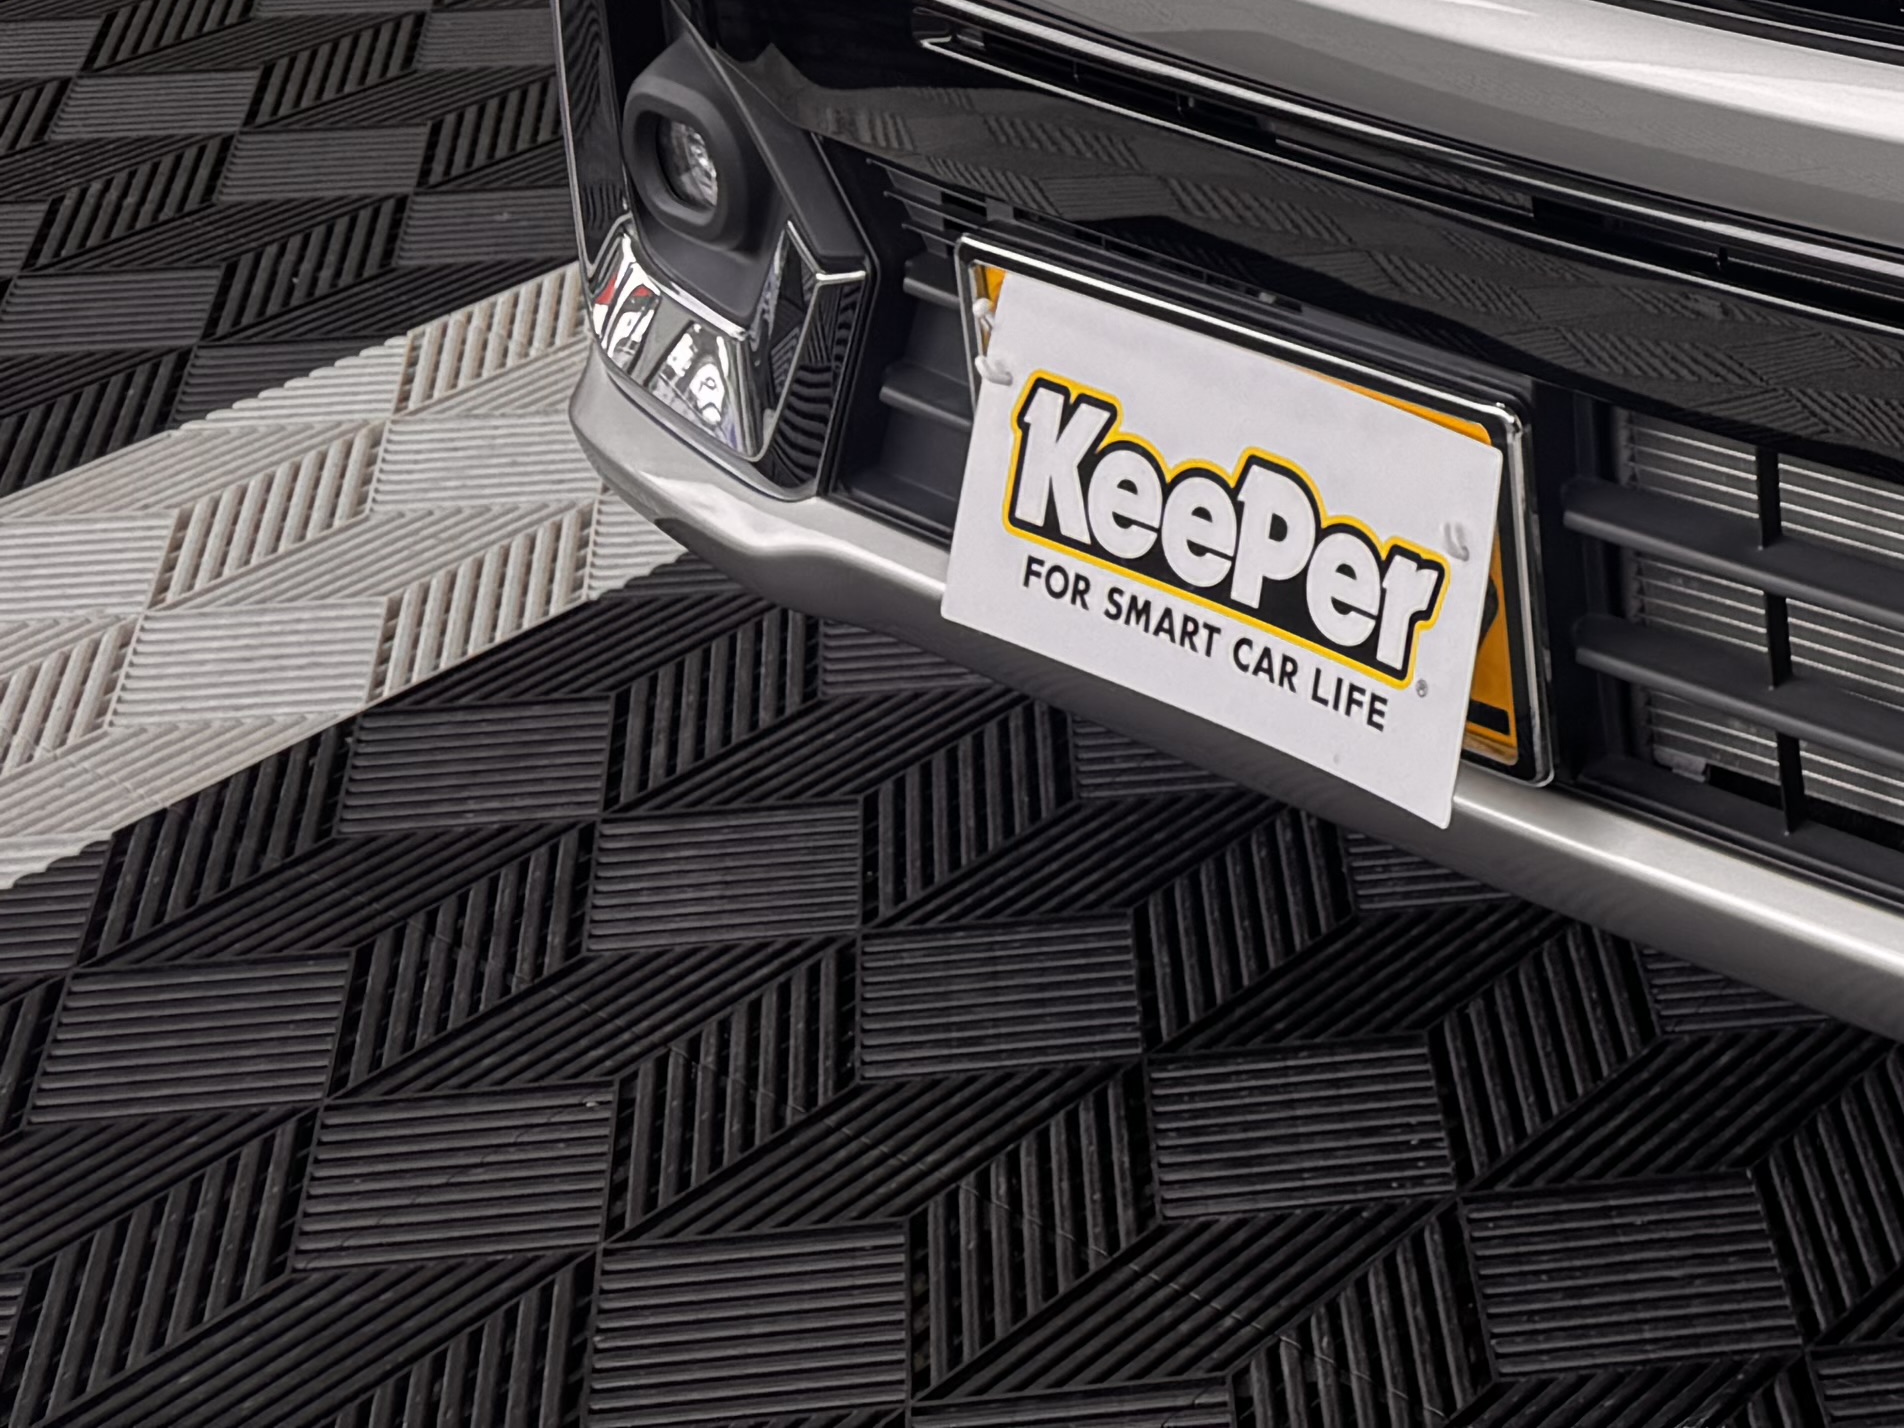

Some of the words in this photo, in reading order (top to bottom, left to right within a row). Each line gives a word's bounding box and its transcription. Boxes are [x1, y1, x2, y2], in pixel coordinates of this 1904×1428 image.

[1006, 373, 1448, 686] KeePer
[1022, 554, 1091, 611] FOR
[1103, 587, 1222, 658] SMART
[1232, 637, 1299, 694] CAR
[1310, 667, 1389, 732] LIFE
